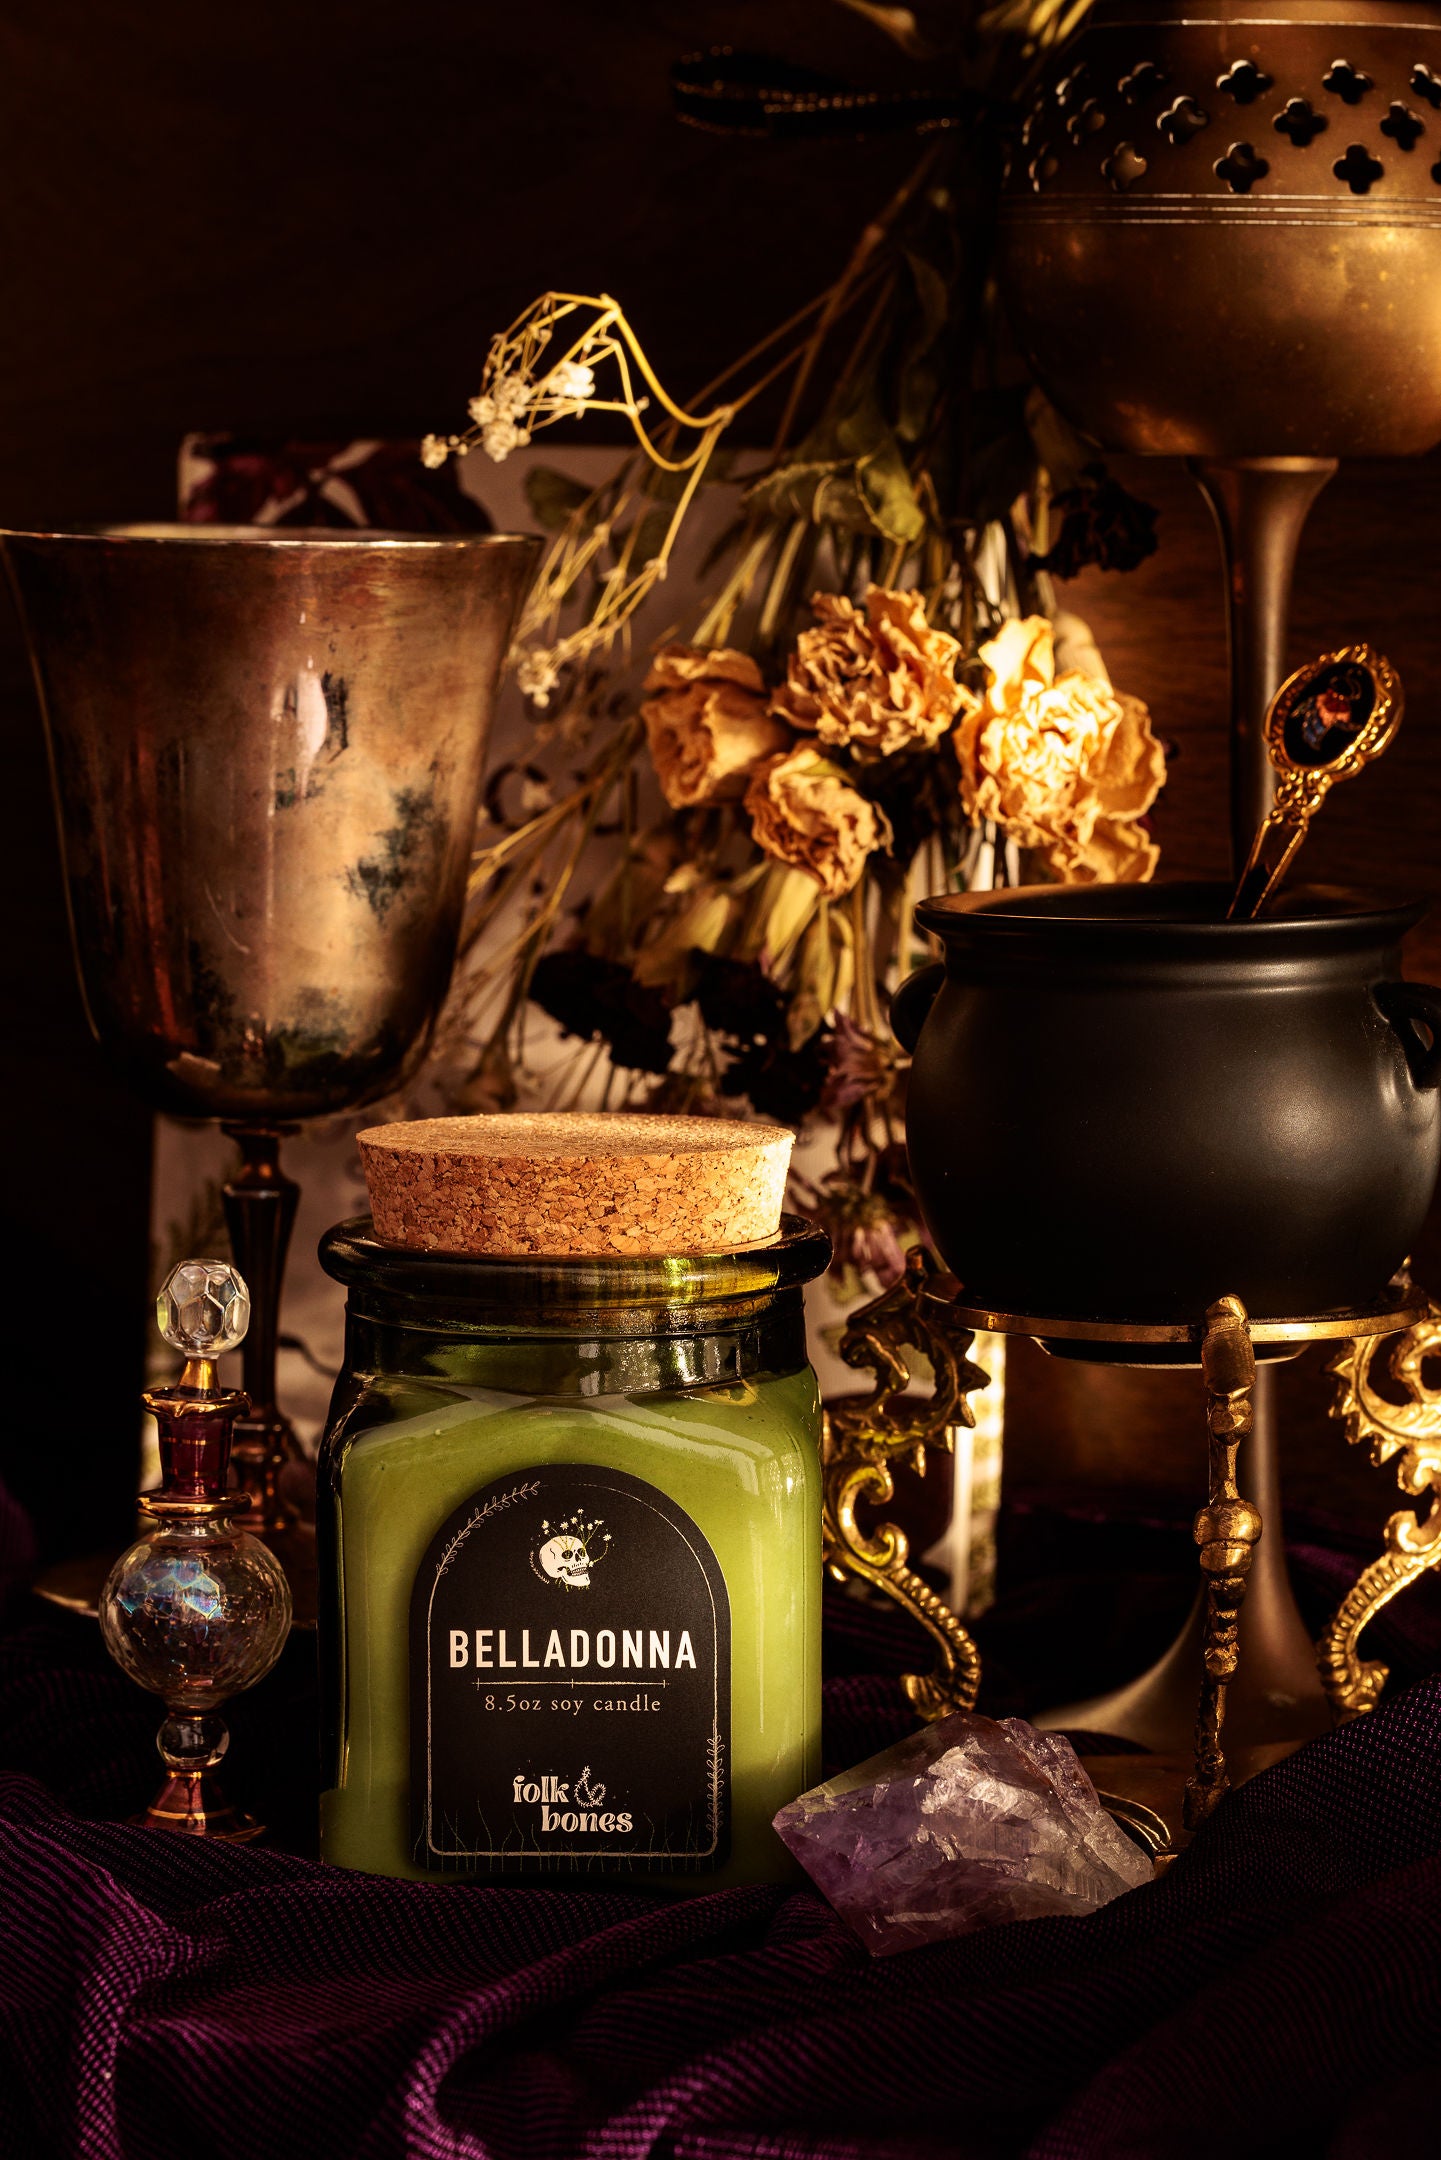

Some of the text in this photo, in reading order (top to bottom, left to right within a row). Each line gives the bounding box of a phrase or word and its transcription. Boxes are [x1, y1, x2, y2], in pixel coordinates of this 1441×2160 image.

[449, 1629, 697, 1669] BELLADONNA
[484, 1694, 662, 1716] 8.5oz soy candle
[512, 1775, 570, 1804] folk
[541, 1805, 634, 1833] bones
